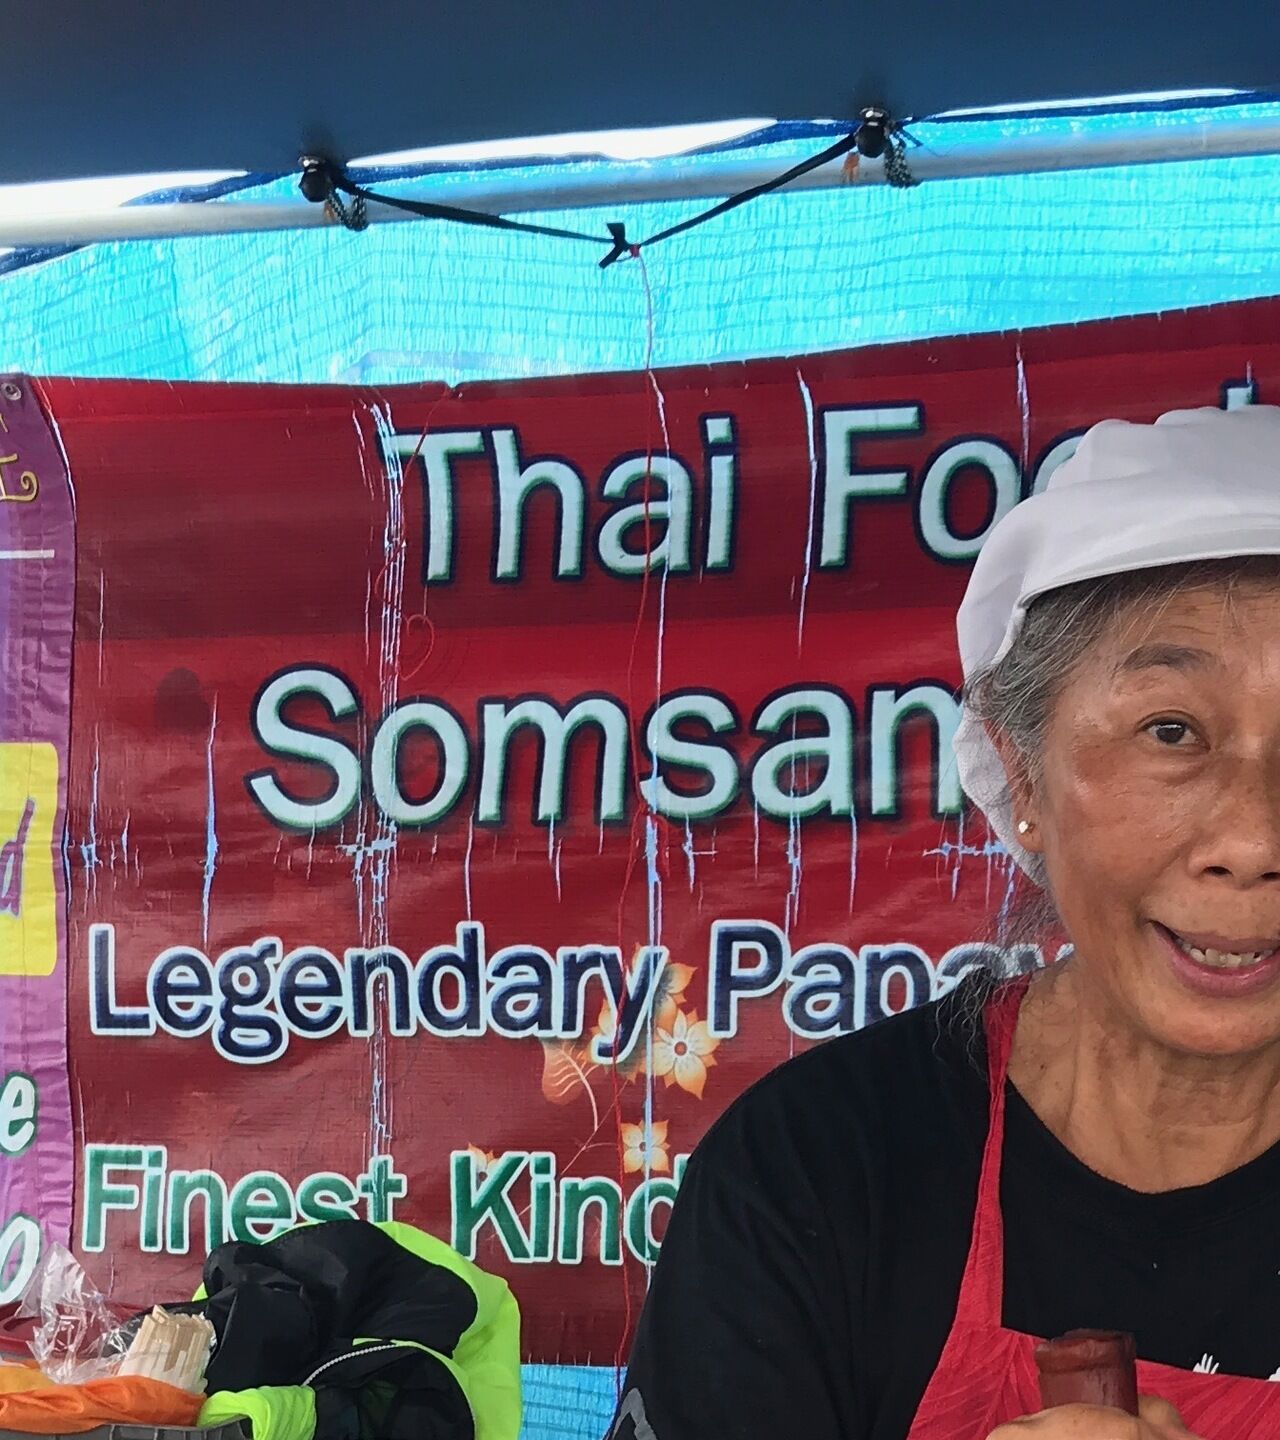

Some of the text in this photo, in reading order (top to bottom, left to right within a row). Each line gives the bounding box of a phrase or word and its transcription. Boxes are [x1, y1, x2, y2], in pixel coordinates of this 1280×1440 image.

[388, 379, 1260, 583] Thai Fo
[88, 919, 668, 1066] Legendary
